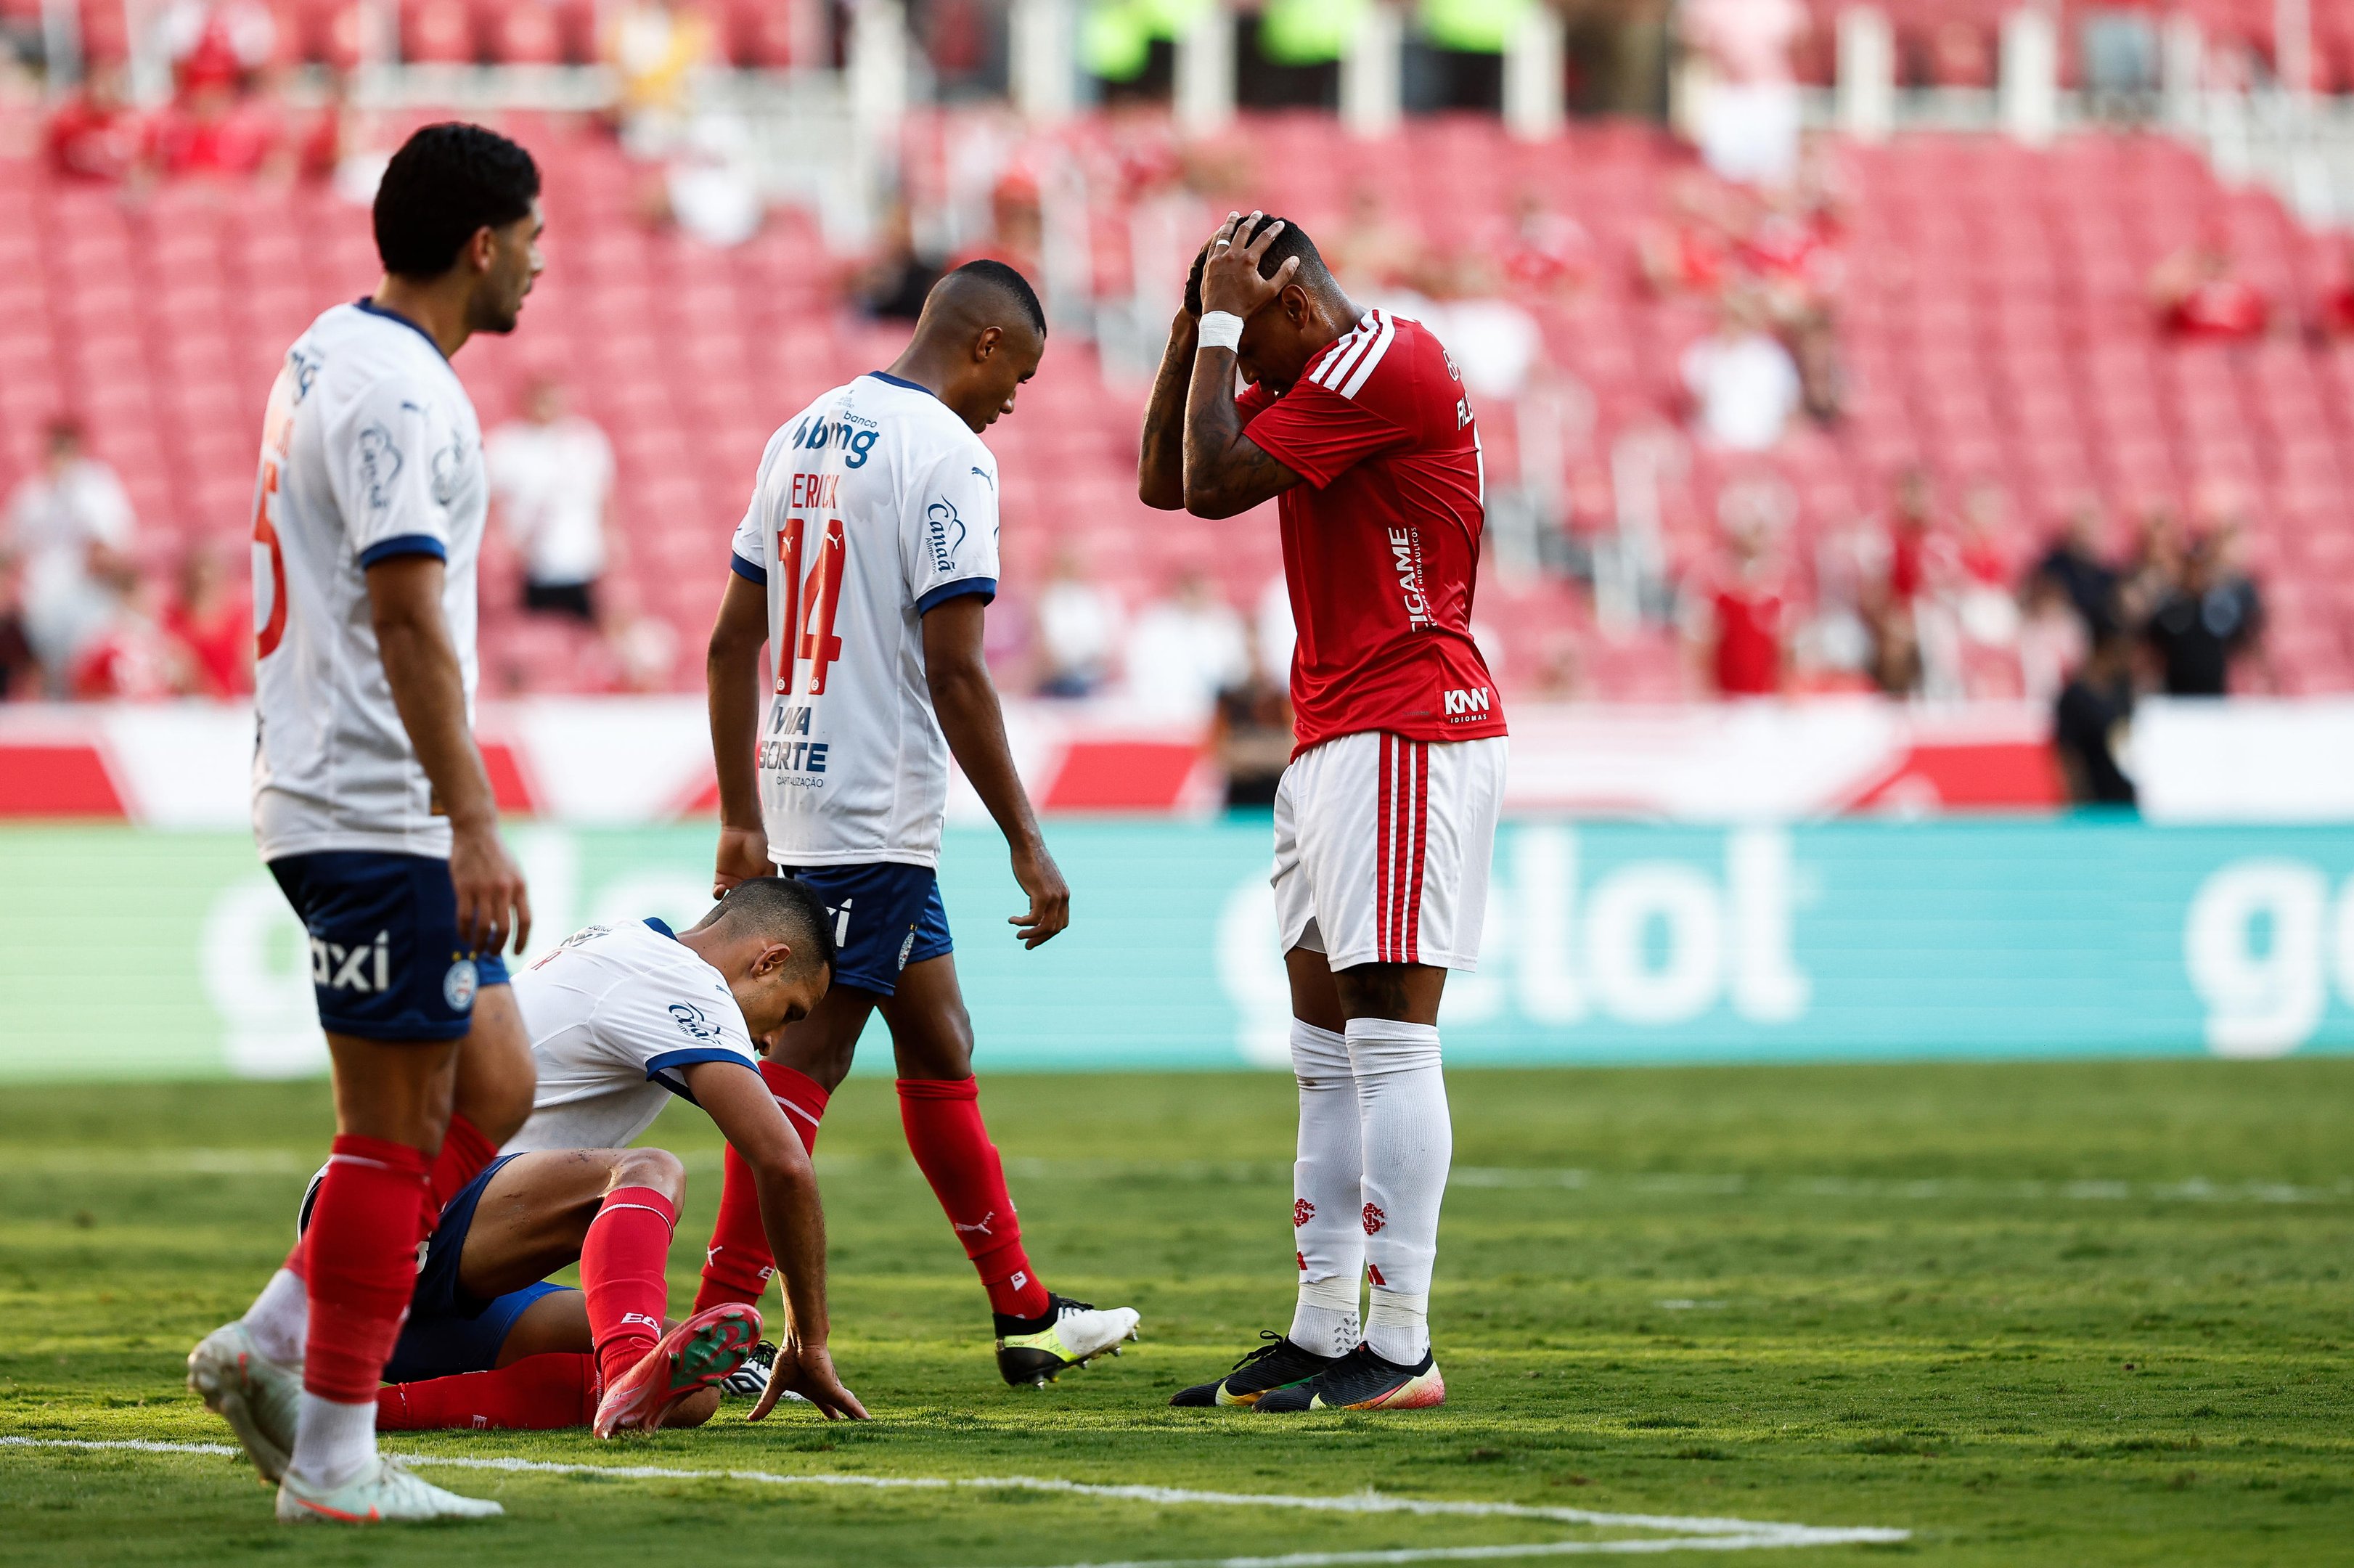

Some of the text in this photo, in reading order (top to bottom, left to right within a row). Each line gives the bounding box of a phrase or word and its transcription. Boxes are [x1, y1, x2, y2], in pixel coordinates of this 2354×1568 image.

[843, 411, 878, 428] banco
[792, 473, 840, 509] ERICK
[927, 503, 956, 573] Canaã
[925, 537, 938, 575] Alimentos
[1410, 527, 1423, 584] HIDRÁULICOS
[775, 518, 846, 695] 14
[1444, 687, 1489, 715] KNN
[1450, 714, 1487, 724] IDIOMAS
[759, 740, 829, 773] SORTE
[776, 776, 824, 790] CAPTALIZAÇÃO
